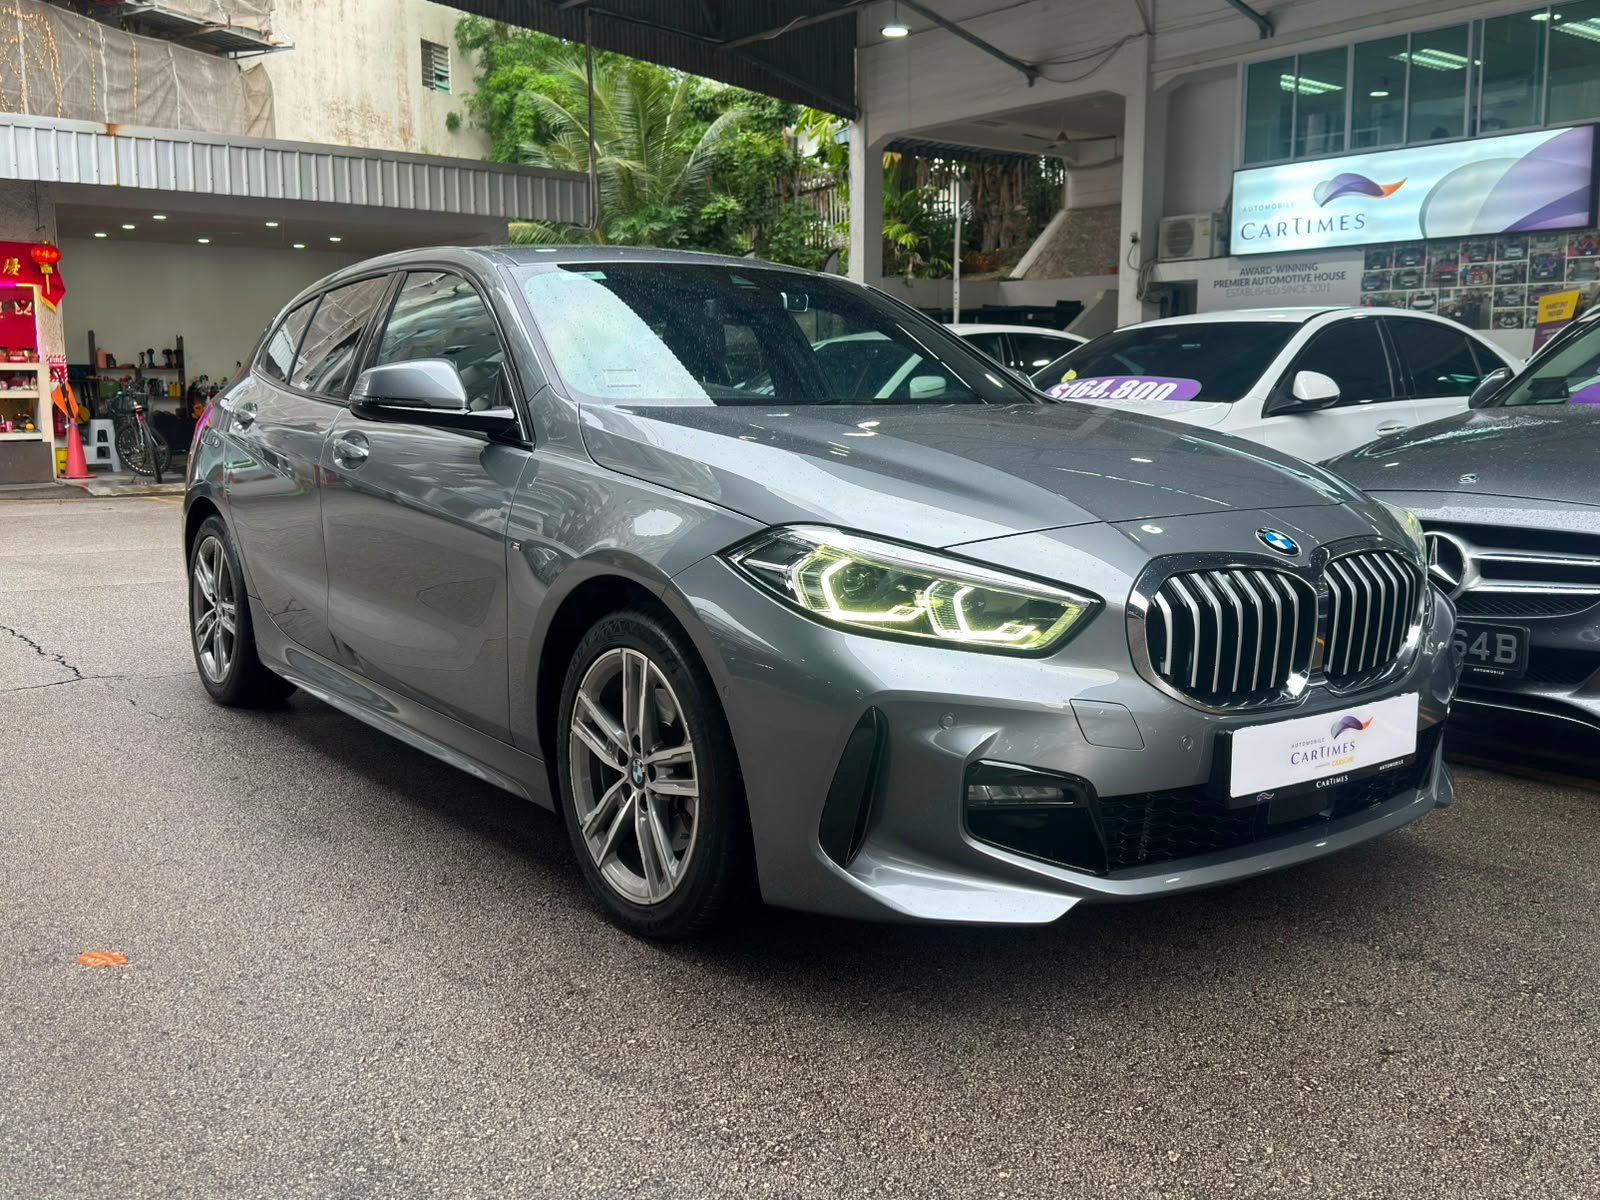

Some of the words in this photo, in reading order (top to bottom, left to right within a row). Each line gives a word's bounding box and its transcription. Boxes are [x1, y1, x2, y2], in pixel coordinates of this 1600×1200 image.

[1243, 202, 1295, 213] AUTOMOBILE
[1240, 262, 1318, 276] AWARD-WINNING
[1213, 279, 1250, 288] PREMIER
[1251, 273, 1312, 286] AUTOMOTIVE
[1313, 271, 1347, 281] HOUSE
[1225, 287, 1280, 298] ESTABLISHED
[1281, 284, 1310, 295] SINCE
[1309, 282, 1331, 293] 2001
[1050, 379, 1178, 401] $164,800
[1473, 667, 1504, 675] AUTOMOBILE
[1291, 738, 1325, 748] AUTOMOBILE
[1379, 760, 1404, 770] AUTOMOBILE
